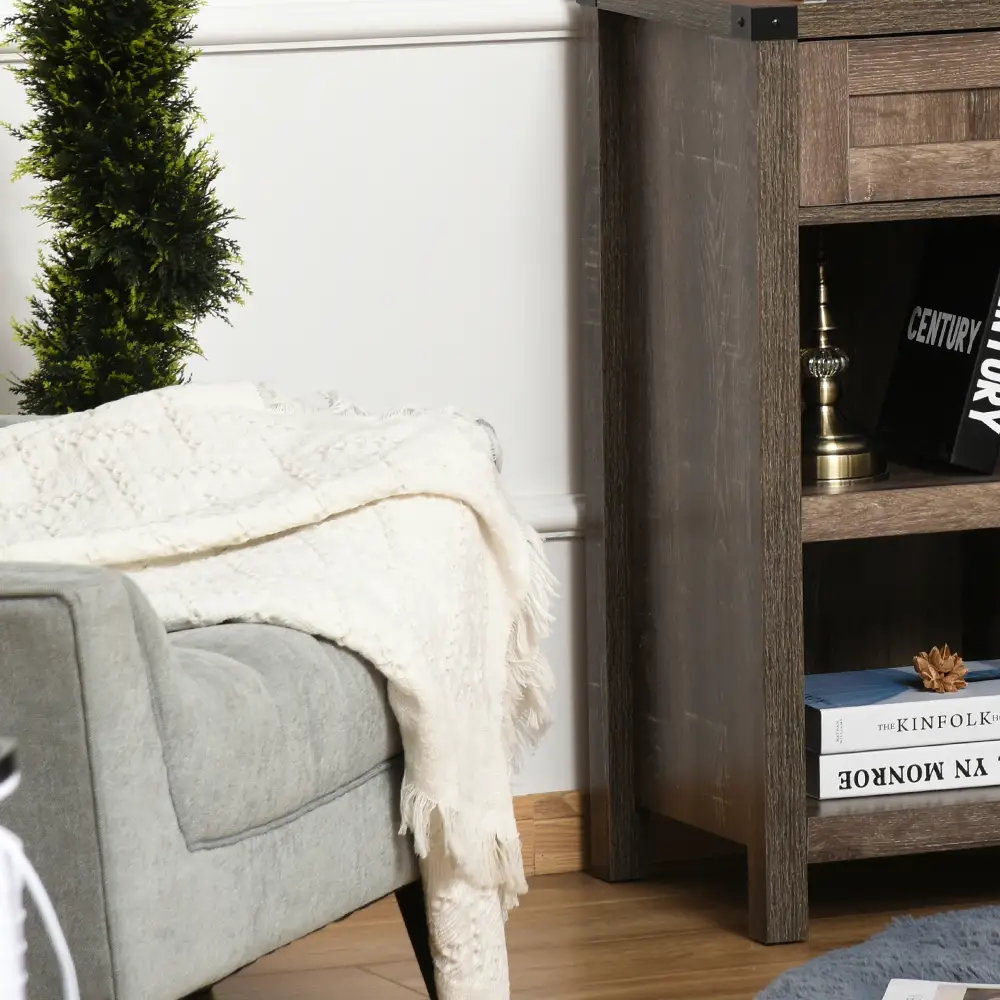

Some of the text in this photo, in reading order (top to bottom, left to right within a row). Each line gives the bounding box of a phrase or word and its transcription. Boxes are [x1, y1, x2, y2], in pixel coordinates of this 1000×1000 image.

[907, 305, 982, 355] CENTURY
[877, 723, 896, 732] THE
[896, 711, 992, 733] KINFOLK
[838, 761, 945, 790] MONROE
[954, 757, 989, 779] YN
